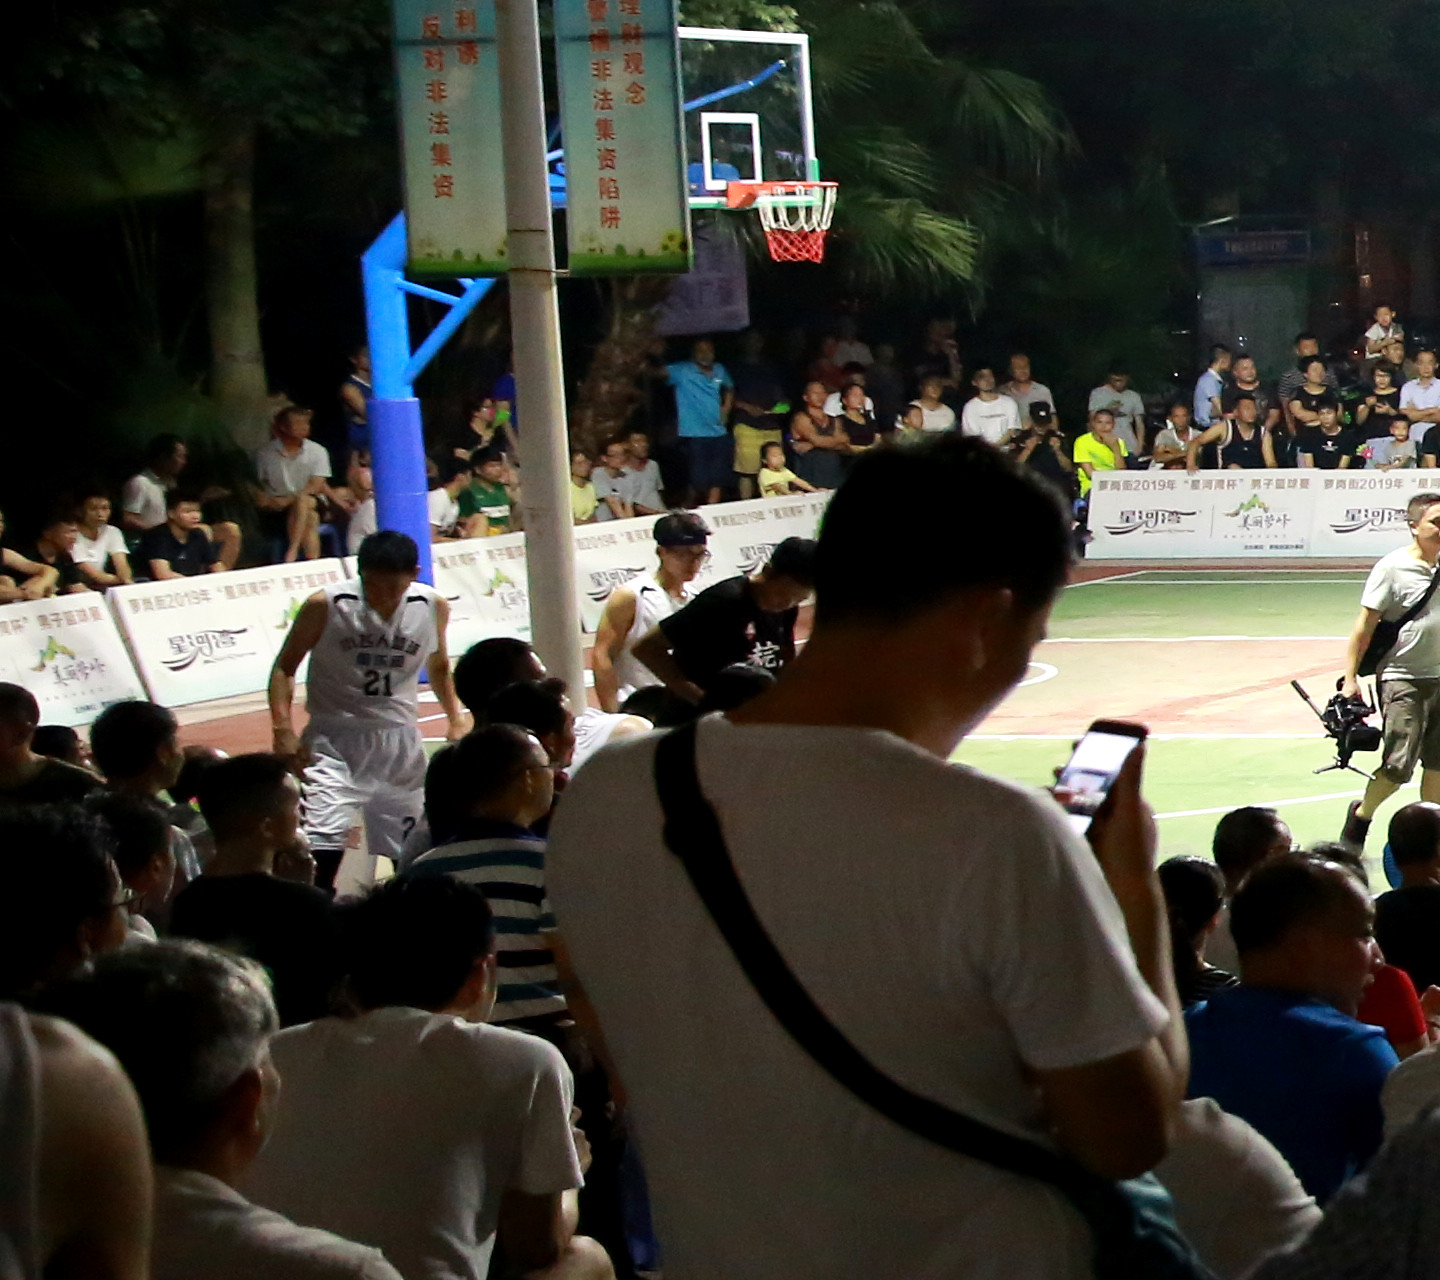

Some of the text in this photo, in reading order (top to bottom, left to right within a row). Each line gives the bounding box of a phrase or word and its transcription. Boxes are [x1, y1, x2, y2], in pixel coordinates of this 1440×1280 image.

[421, 15, 454, 200] 反对非法集资
[364, 669, 392, 696] 21
